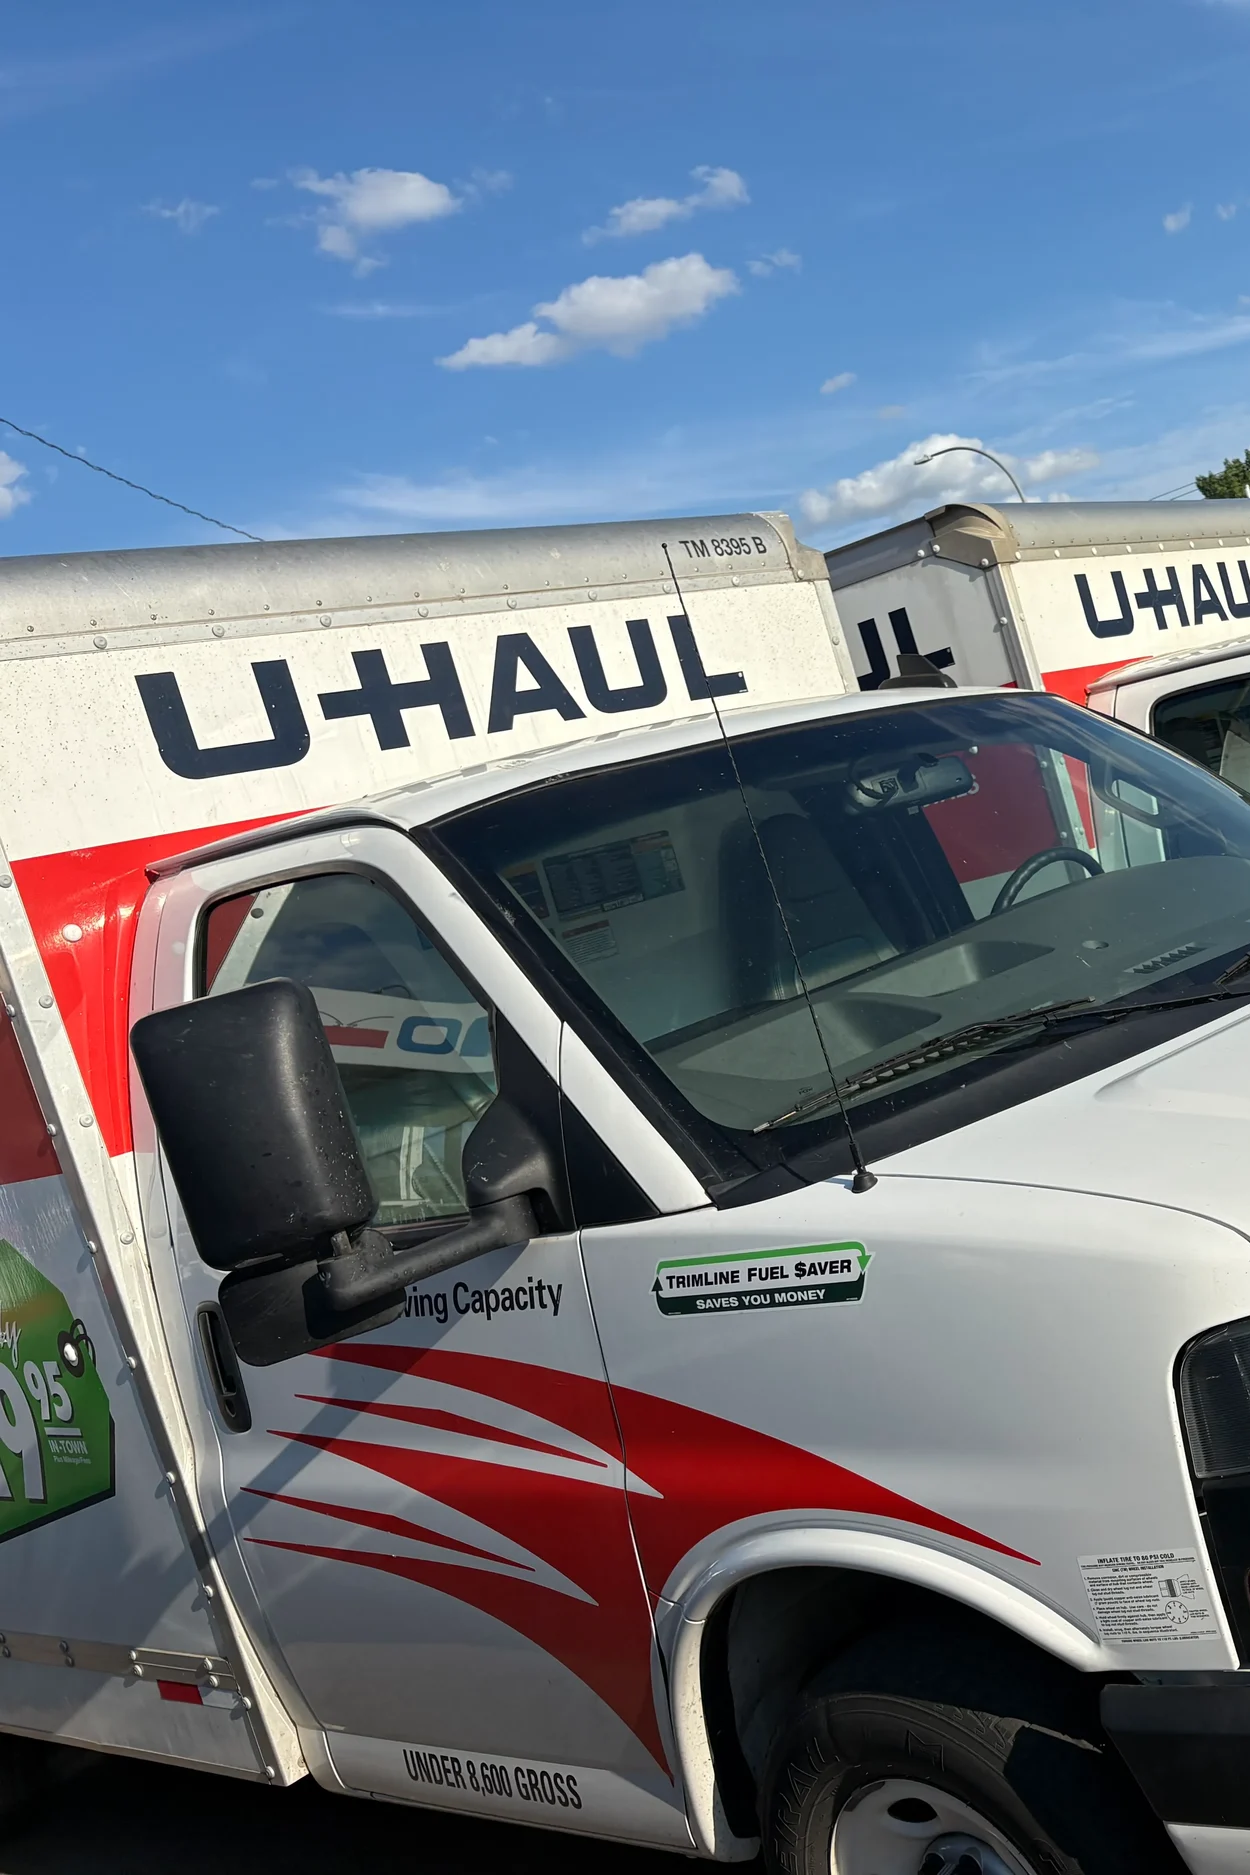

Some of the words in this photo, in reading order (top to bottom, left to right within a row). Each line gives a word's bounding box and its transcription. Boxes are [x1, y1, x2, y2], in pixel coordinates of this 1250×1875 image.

[679, 540, 711, 558] TM
[711, 537, 751, 557] 8395
[751, 536, 767, 554] B
[135, 615, 748, 780] U-HAUL
[666, 1270, 740, 1290] TRIMLINE
[747, 1265, 790, 1283] FUEL
[794, 1259, 852, 1280] $AVER
[453, 1276, 562, 1320] Capacity
[696, 1296, 739, 1310] SAVES
[741, 1293, 771, 1306] YOU
[774, 1289, 826, 1303] MONEY
[23, 1360, 73, 1422] 95
[48, 1440, 88, 1454] IN-TOWN
[402, 1749, 467, 1790] UNDER
[466, 1760, 513, 1797] 8,600
[514, 1767, 583, 1810] GROSS
